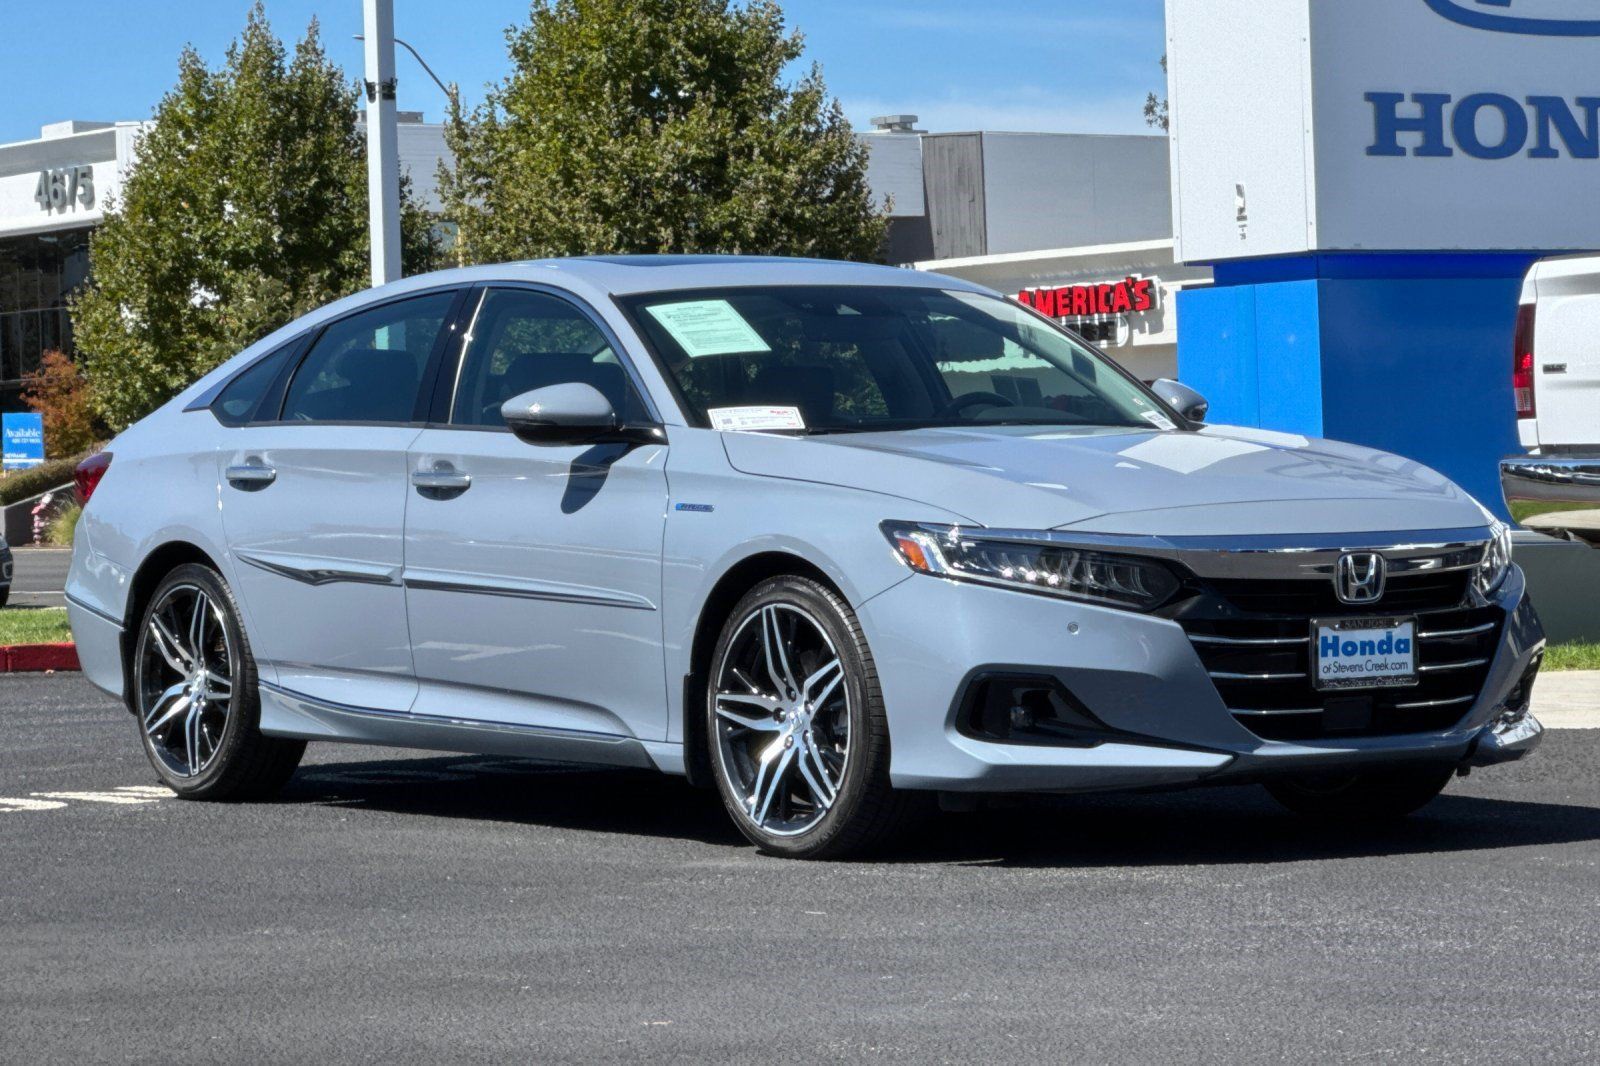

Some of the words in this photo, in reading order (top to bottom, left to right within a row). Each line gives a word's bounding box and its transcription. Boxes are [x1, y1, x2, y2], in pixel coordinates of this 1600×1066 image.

[34, 166, 94, 210] 4675
[1018, 276, 1151, 317] AMERICA'S
[6, 428, 40, 438] Available
[1320, 631, 1410, 658] Honda
[1322, 664, 1331, 674] of
